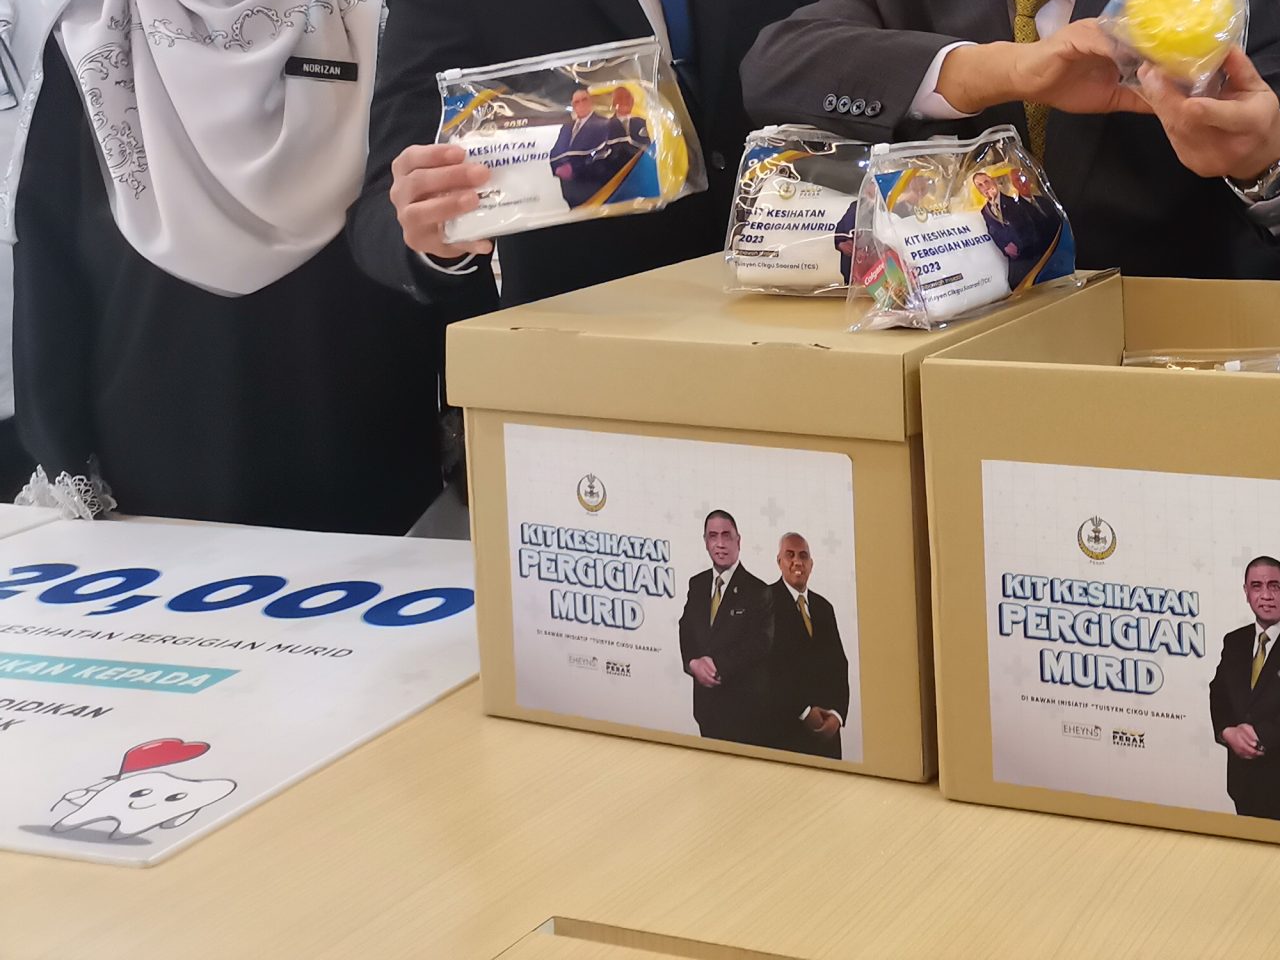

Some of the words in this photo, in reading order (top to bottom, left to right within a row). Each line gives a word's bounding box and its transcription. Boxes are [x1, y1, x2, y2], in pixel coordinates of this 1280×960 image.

[303, 63, 340, 75] NORIZAN
[468, 141, 537, 157] KESIHATAN
[512, 152, 549, 164] MURID
[767, 209, 826, 218] KESIHATAN
[743, 221, 800, 231] PERGIGIAN
[802, 222, 836, 232] MURID
[904, 235, 920, 246] KIT
[922, 225, 971, 242] KESIHATAN
[739, 234, 764, 244] 2023
[910, 241, 962, 260] PERGIGIAN
[962, 234, 992, 248] MURID
[916, 261, 941, 276] 2023
[521, 522, 556, 546] KIT
[558, 527, 670, 562] KESIHATAN
[519, 548, 675, 598] PERGIGIAN
[1002, 573, 1048, 601] KIT
[1050, 578, 1200, 617] KESIHATAN
[550, 589, 645, 630] MURID
[999, 602, 1206, 658] PERGIGIAN
[0, 624, 124, 641] ESIHATAN
[122, 632, 266, 652] PERGIGIAN
[266, 643, 353, 657] MURID
[72, 665, 212, 688] KEPADA
[1040, 648, 1164, 694] MURID
[1030, 696, 1056, 704] BAWAH
[1058, 699, 1088, 708] INISIATIF
[1063, 724, 1099, 737] EHEYNS
[1112, 734, 1144, 744] PERAK
